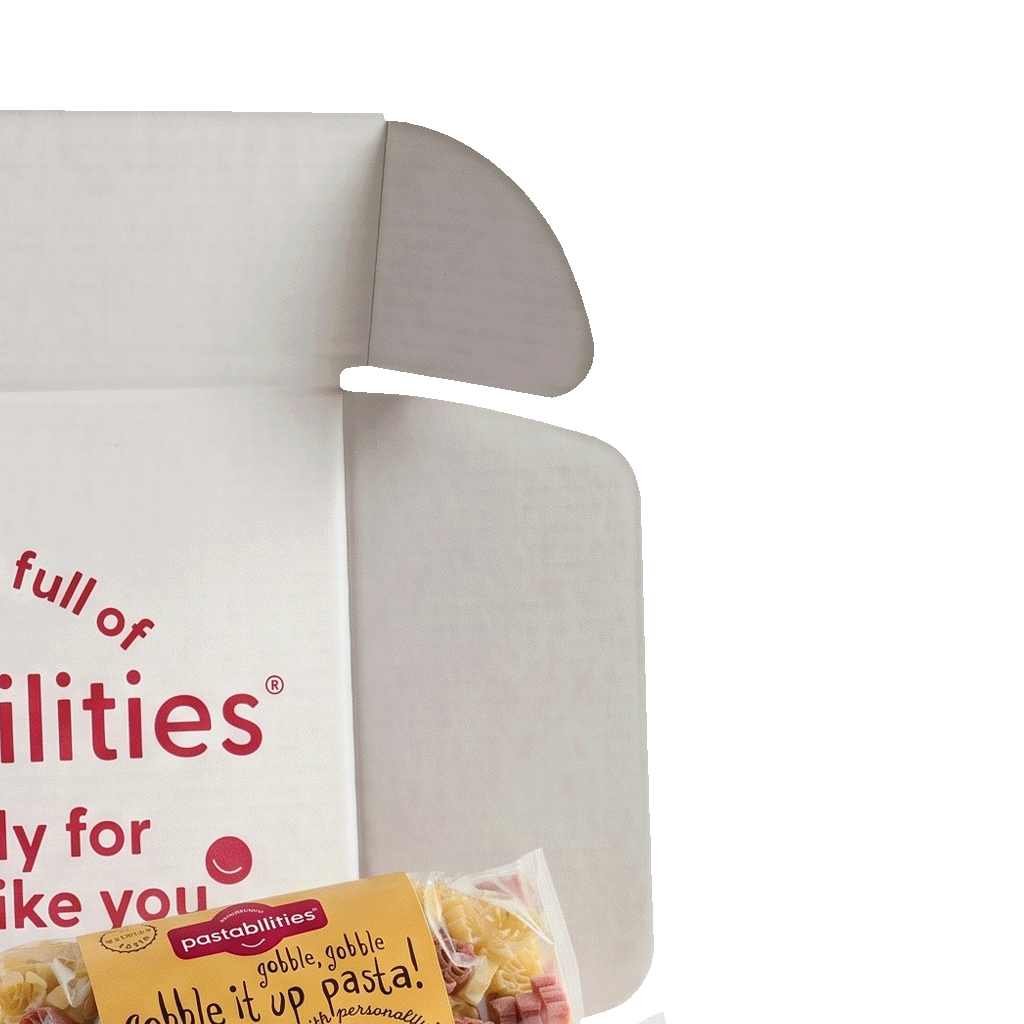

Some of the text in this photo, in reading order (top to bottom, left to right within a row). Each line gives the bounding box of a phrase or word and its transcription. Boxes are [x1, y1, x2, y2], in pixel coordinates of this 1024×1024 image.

[13, 550, 97, 615] full
[96, 608, 154, 650] of
[67, 806, 151, 857] for
[100, 885, 207, 929] you
[229, 980, 261, 1023] it
[321, 936, 424, 1018] pasta!
[257, 930, 386, 988] gobble, gobble
